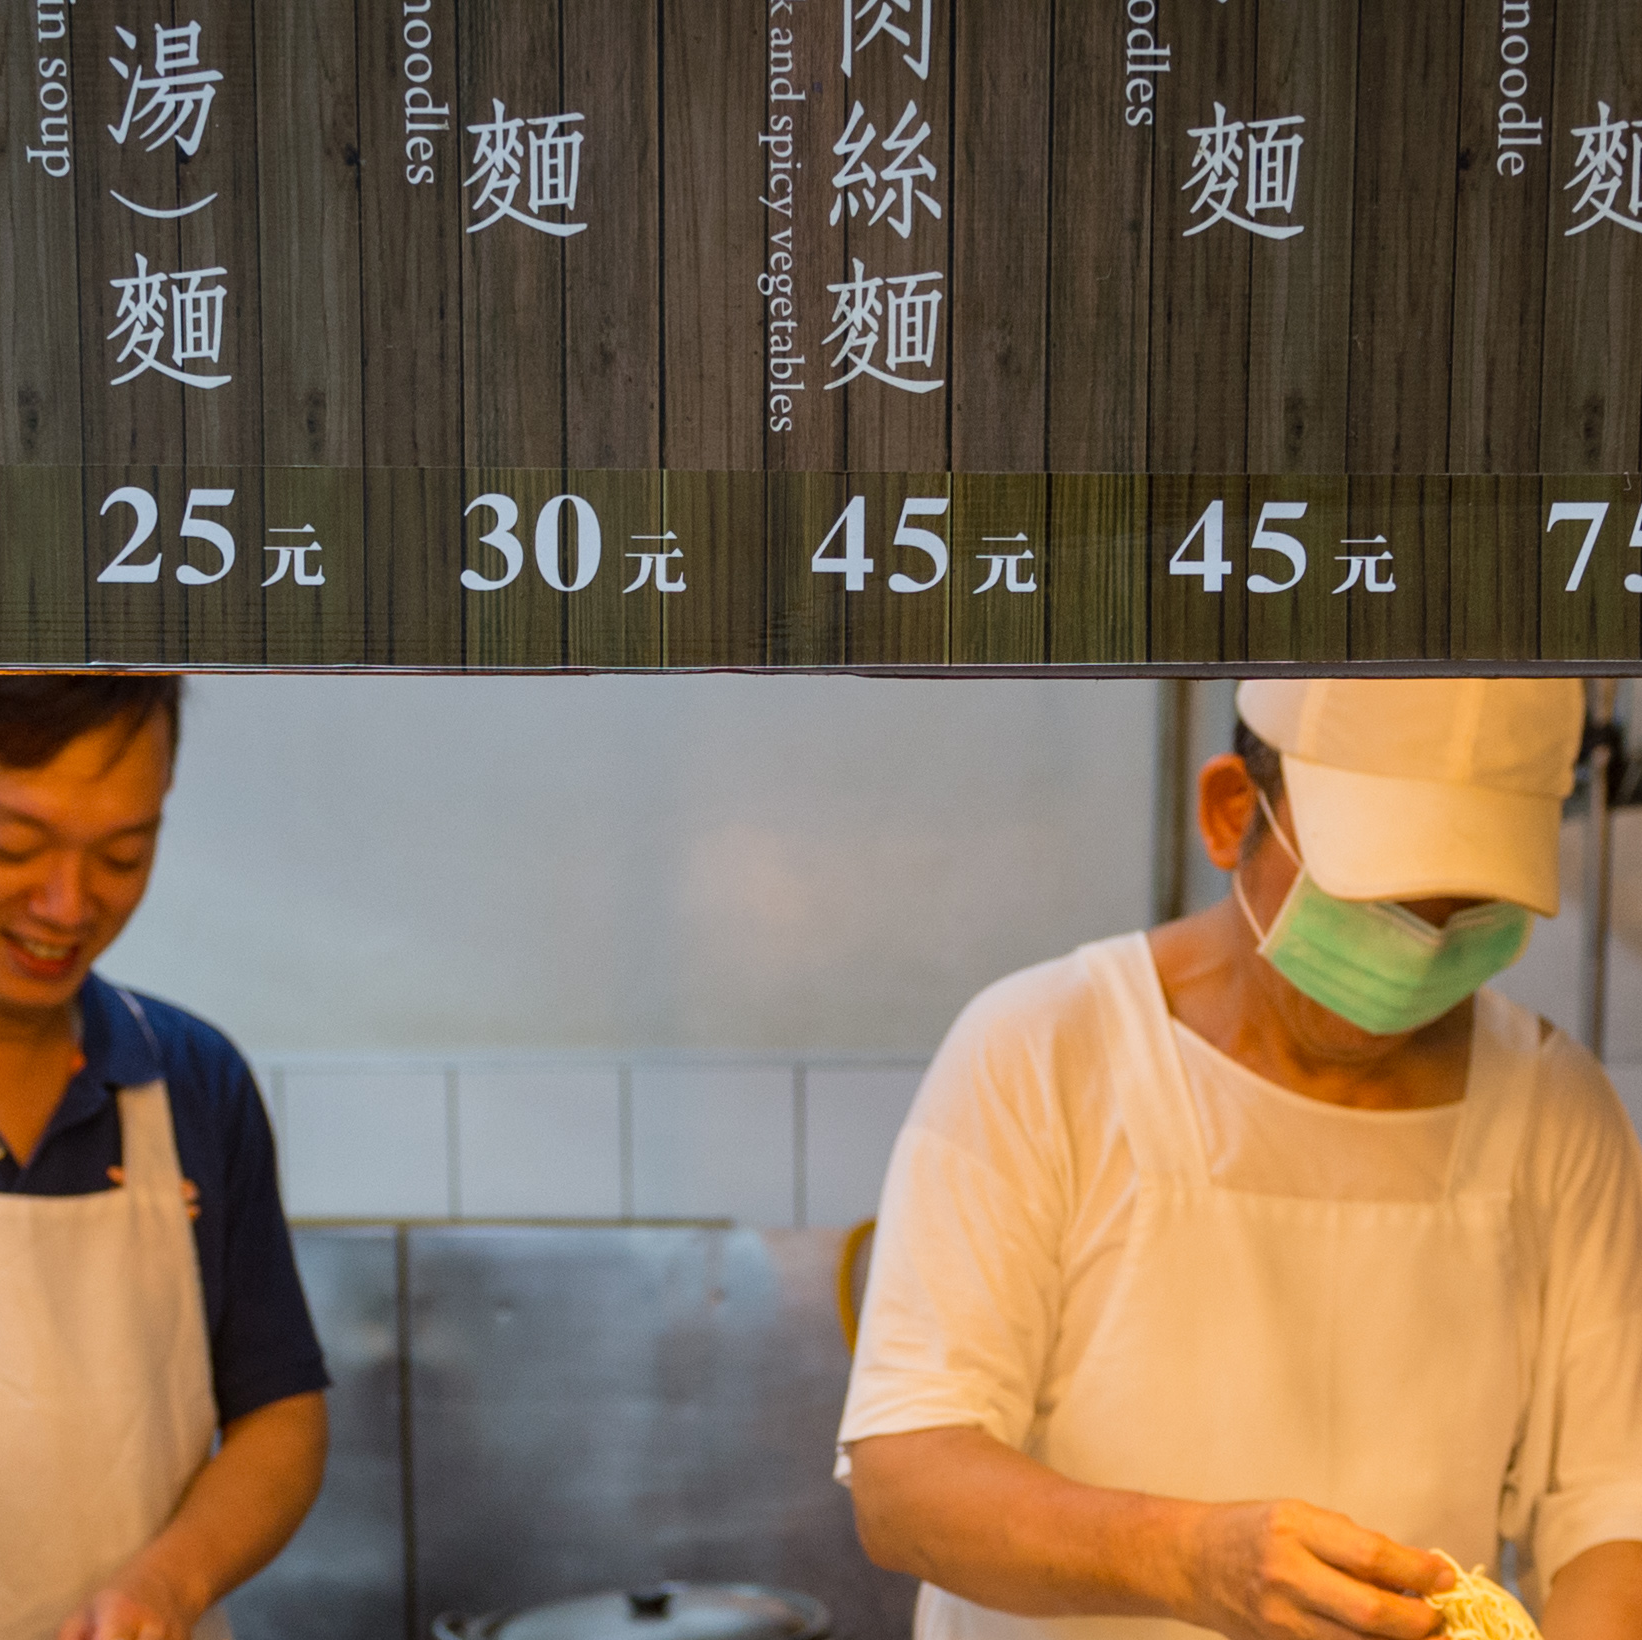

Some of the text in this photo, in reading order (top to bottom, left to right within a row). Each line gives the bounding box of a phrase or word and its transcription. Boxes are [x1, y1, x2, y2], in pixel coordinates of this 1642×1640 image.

[26, 58, 72, 177] soup
[769, 27, 806, 102] and
[1496, 0, 1543, 177] noodle
[462, 97, 588, 237] 麵
[757, 114, 803, 219] spicy
[1181, 101, 1306, 240] 麵
[757, 226, 806, 432] vegetables
